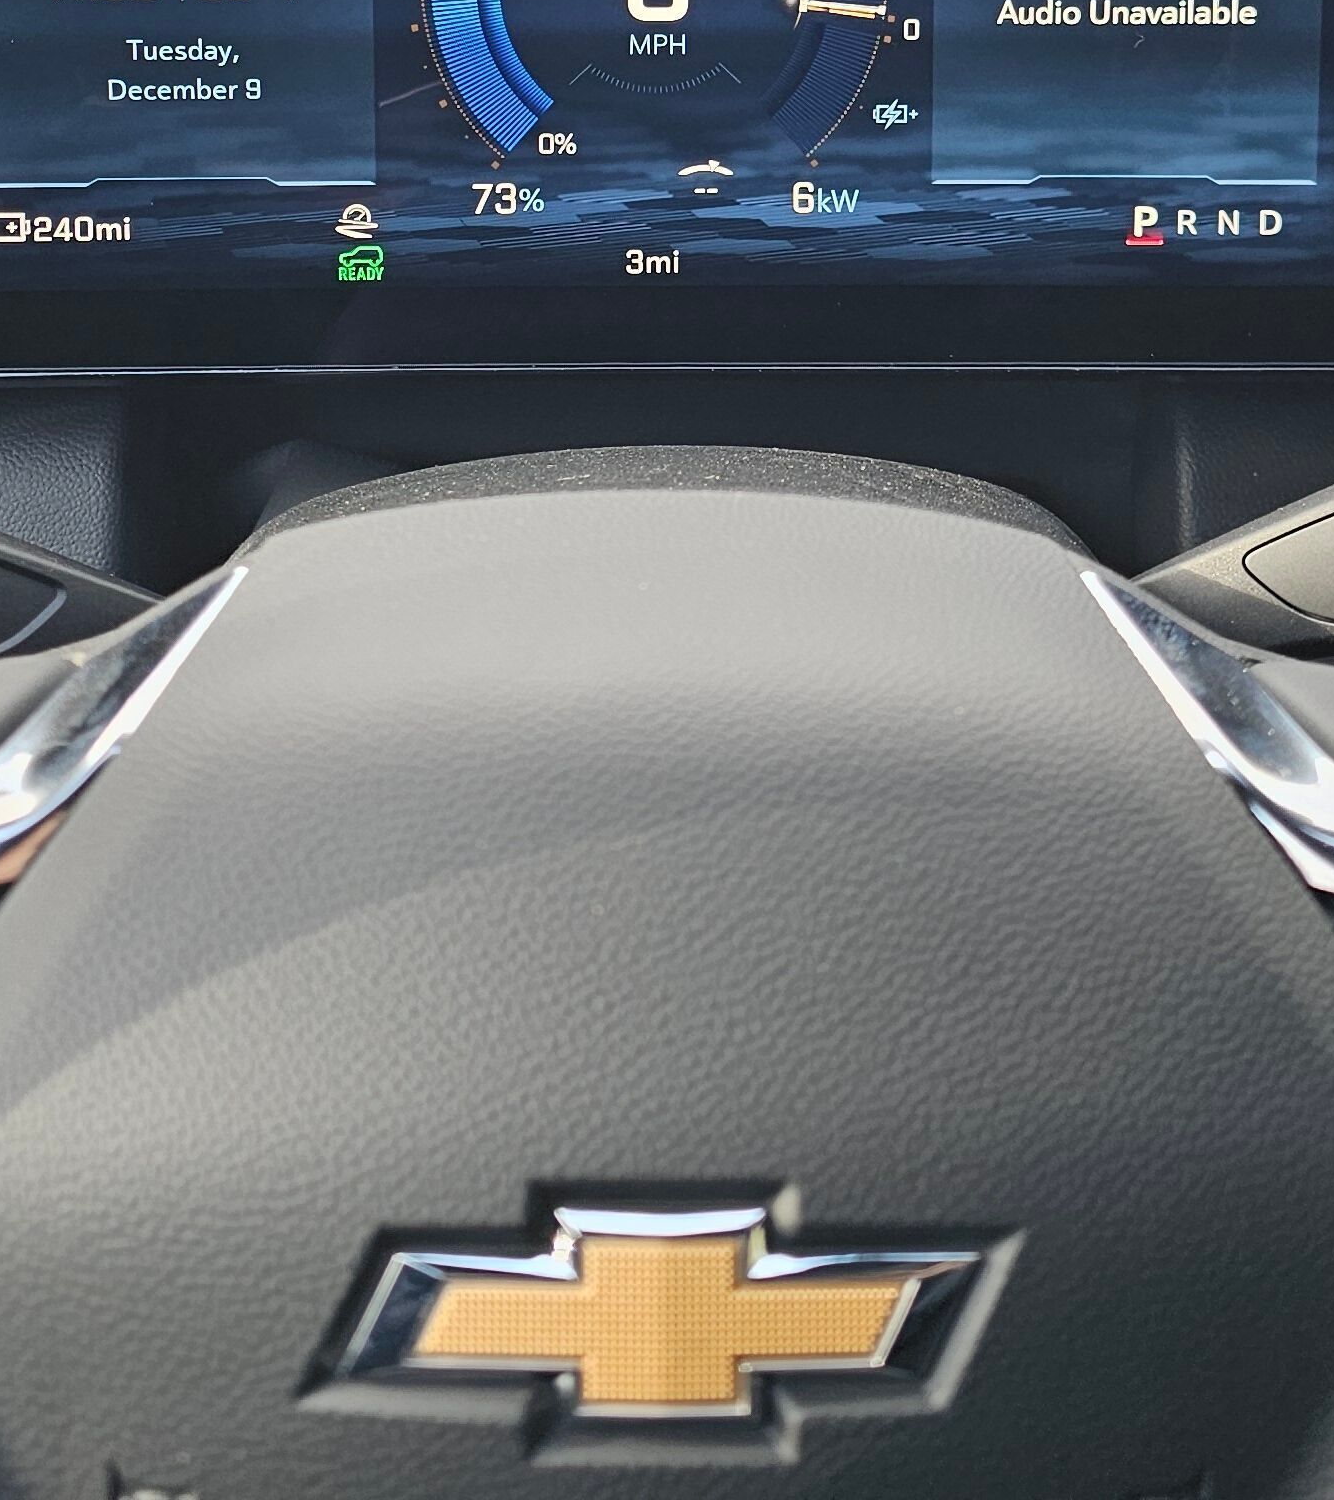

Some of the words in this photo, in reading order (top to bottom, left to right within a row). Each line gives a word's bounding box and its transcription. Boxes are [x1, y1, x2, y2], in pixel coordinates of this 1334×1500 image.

[903, 18, 921, 41] 0
[125, 37, 240, 67] Tuesday,
[629, 33, 686, 56] MPH
[107, 77, 238, 101] December
[245, 78, 261, 100] 9
[538, 132, 577, 155] 0%
[471, 182, 546, 215] 73%
[792, 182, 859, 214] 6kW
[33, 215, 131, 242] 240mi
[1132, 205, 1159, 236] P
[1177, 209, 1198, 236] R
[1217, 209, 1240, 236] N
[1259, 209, 1283, 236] D
[338, 266, 384, 282] READY
[625, 248, 680, 275] 3mi
